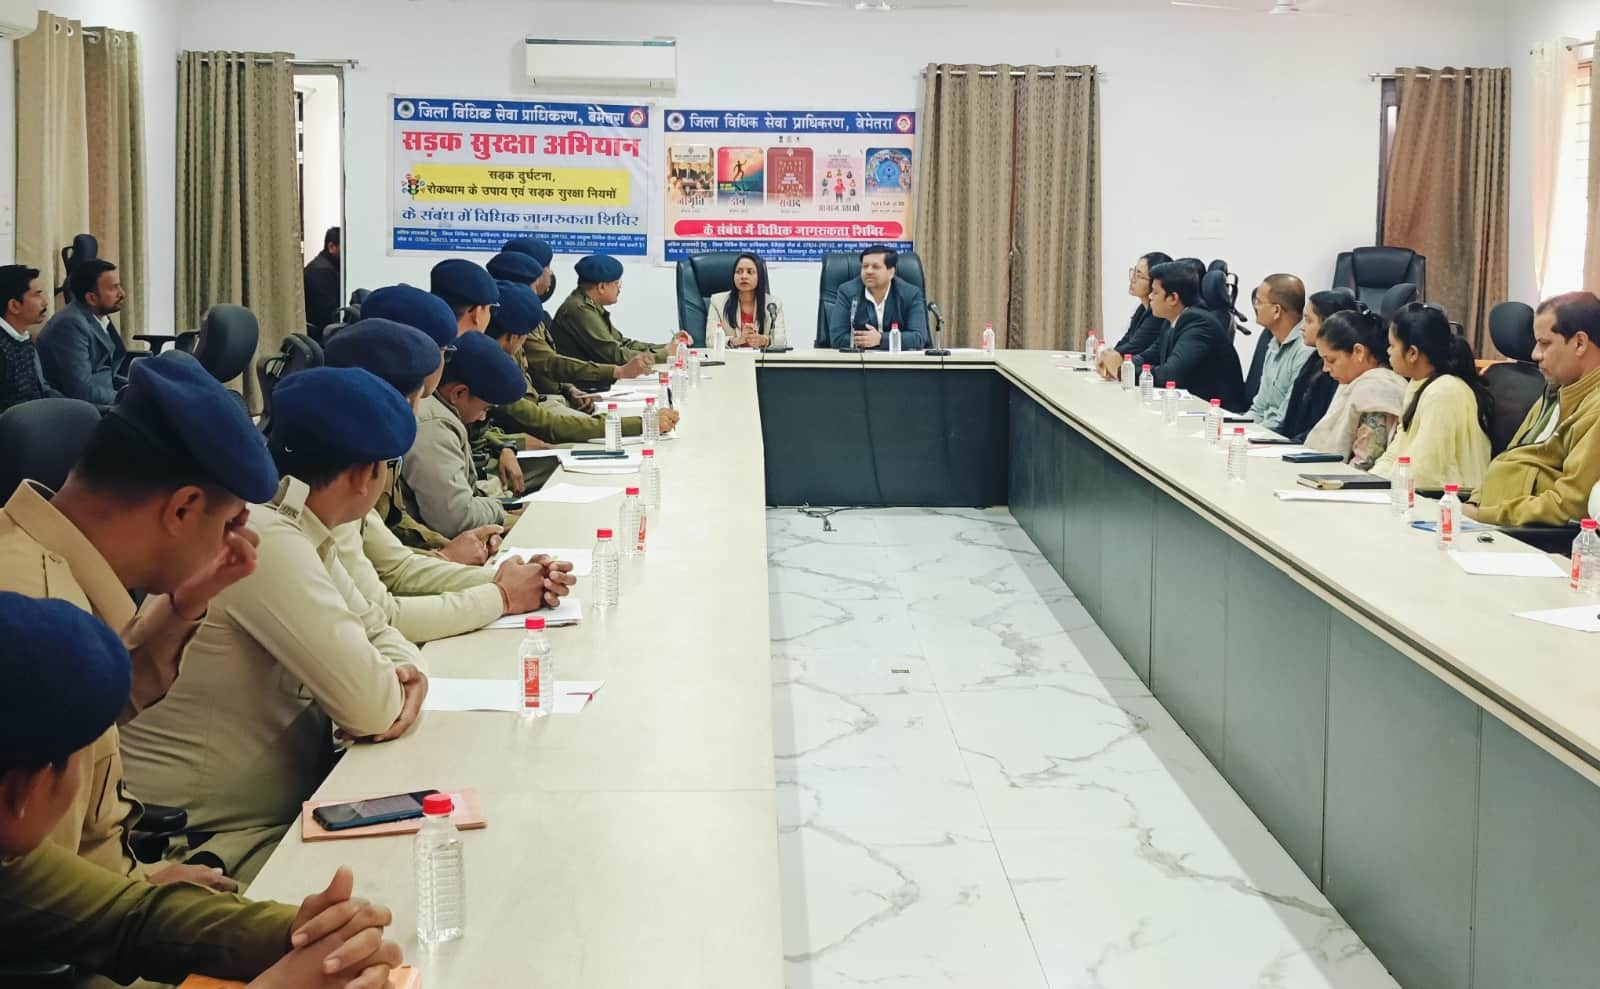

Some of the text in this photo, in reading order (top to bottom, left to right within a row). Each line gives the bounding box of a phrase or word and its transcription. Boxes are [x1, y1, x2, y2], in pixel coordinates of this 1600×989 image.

[418, 101, 448, 120] जिला
[452, 102, 492, 120] विधिक
[495, 103, 518, 121] सेवा
[522, 104, 584, 125] प्राधिकरण,
[689, 113, 719, 129] जिला
[724, 113, 759, 129] विधिक
[764, 112, 788, 129] सेवा
[792, 113, 849, 131] प्राधिकरण,
[401, 130, 642, 160] सड़क सुरक्षा अभियान
[427, 182, 465, 195] रोकथाम
[468, 182, 478, 195] के
[481, 185, 508, 196] उपाय
[511, 184, 525, 198] एवं
[559, 187, 584, 201] सुरक्षा
[587, 186, 617, 199] नियमों
[402, 207, 417, 221] के
[420, 207, 454, 222] संबंध
[457, 207, 472, 222] में
[475, 208, 520, 223] विधिक
[597, 211, 639, 226] शिविर
[703, 223, 714, 236] के
[717, 223, 742, 236] संबंध
[745, 223, 754, 236] में
[757, 223, 792, 236] विधिक
[852, 224, 884, 237] शिविर
